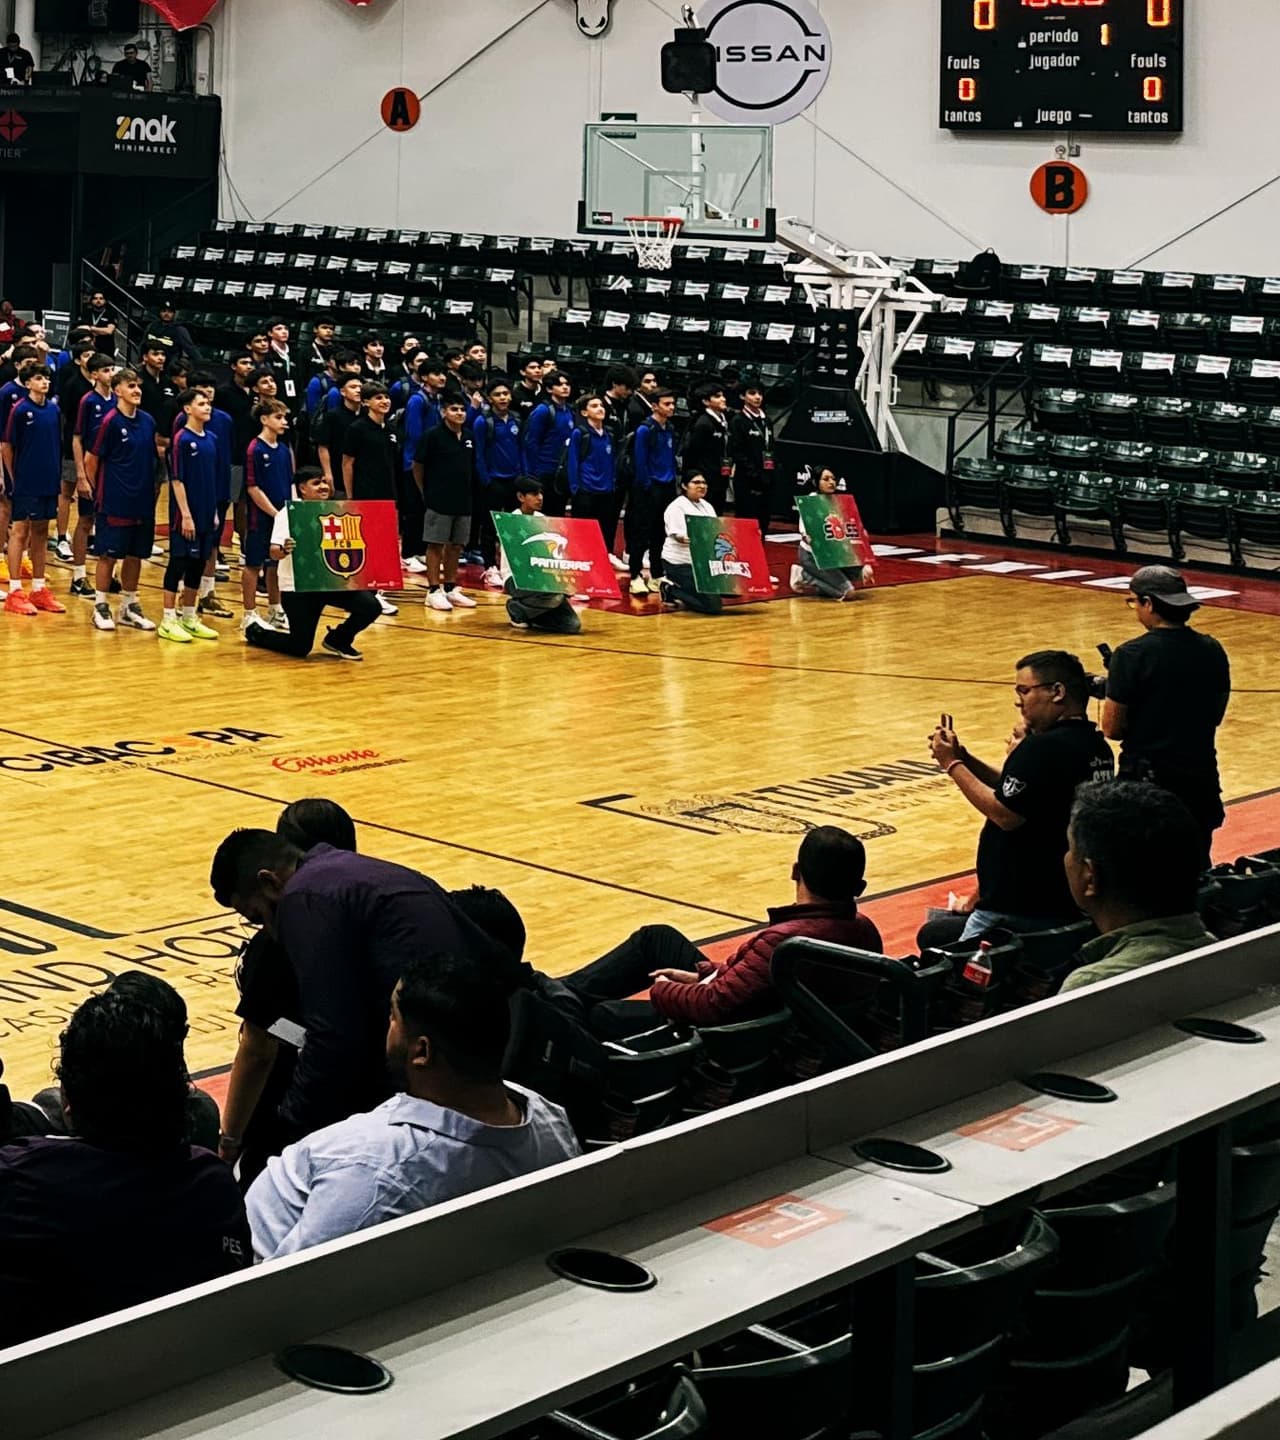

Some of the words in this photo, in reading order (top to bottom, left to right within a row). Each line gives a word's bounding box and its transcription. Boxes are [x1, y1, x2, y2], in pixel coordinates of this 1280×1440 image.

[1100, 23, 1110, 46] 1
[716, 45, 826, 63] ISSAN
[947, 56, 980, 69] fouls
[1028, 53, 1080, 71] jugador
[1130, 53, 1167, 68] fouls
[958, 77, 975, 101] 0
[1143, 76, 1162, 101] 0
[390, 91, 411, 128] A
[945, 110, 981, 122] tantos
[1035, 109, 1072, 124] juego
[1128, 110, 1168, 123] tantos
[115, 143, 178, 155] MINIMARKET
[1044, 166, 1075, 210] B
[530, 558, 591, 572] PANTERAS
[103, 919, 263, 973] HOT
